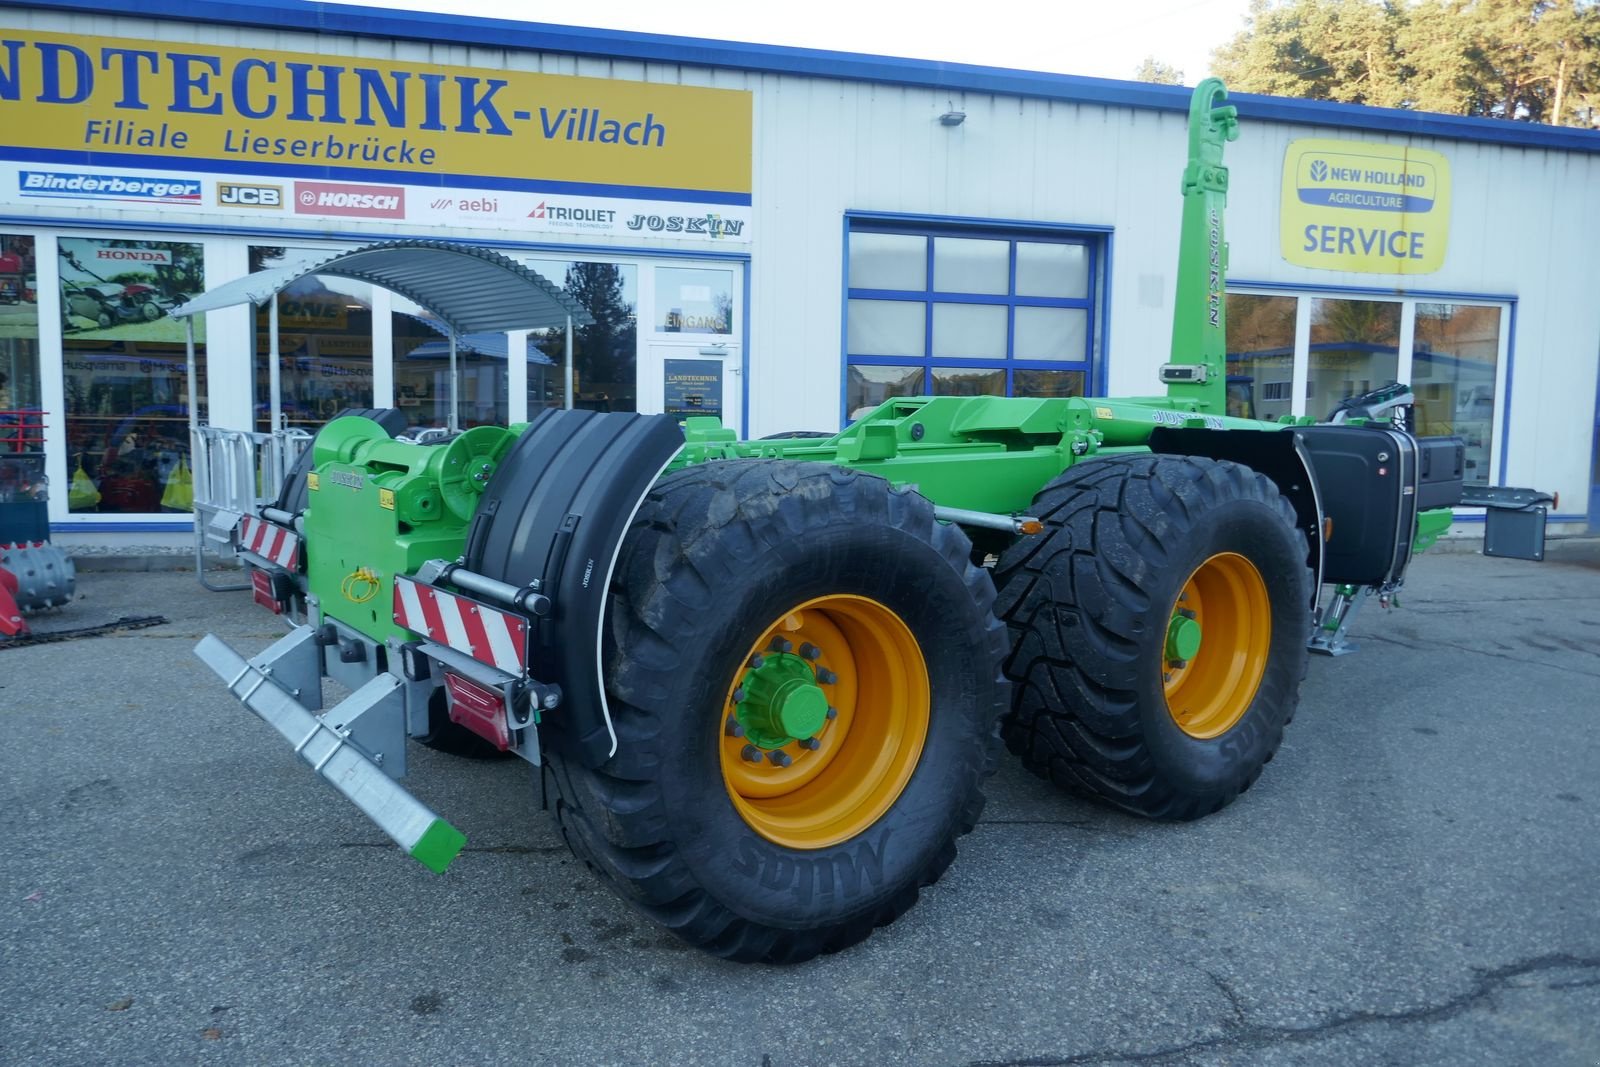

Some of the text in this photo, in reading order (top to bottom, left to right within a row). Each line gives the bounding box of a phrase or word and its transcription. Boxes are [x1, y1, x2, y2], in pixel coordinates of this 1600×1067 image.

[85, 120, 436, 165] Filiale Lieserbrücke
[24, 174, 198, 197] Binderberger
[1330, 167, 1425, 188] NEW HOLLAND
[220, 188, 280, 205] JCB
[318, 191, 400, 210] HORSCH
[458, 197, 498, 212] aebi
[1328, 191, 1403, 208] AGRICULTURE
[546, 206, 616, 223] TRIOLIET
[576, 222, 613, 230] TECHNOLOGY
[626, 213, 745, 237] JOSKIN
[1303, 224, 1424, 259] SERVICE
[97, 249, 168, 262] HONDA
[1208, 208, 1220, 328] JOSKIN
[665, 312, 724, 329] EINGANG
[1152, 409, 1224, 430] JOSIN
[582, 559, 594, 588] JOSKIN
